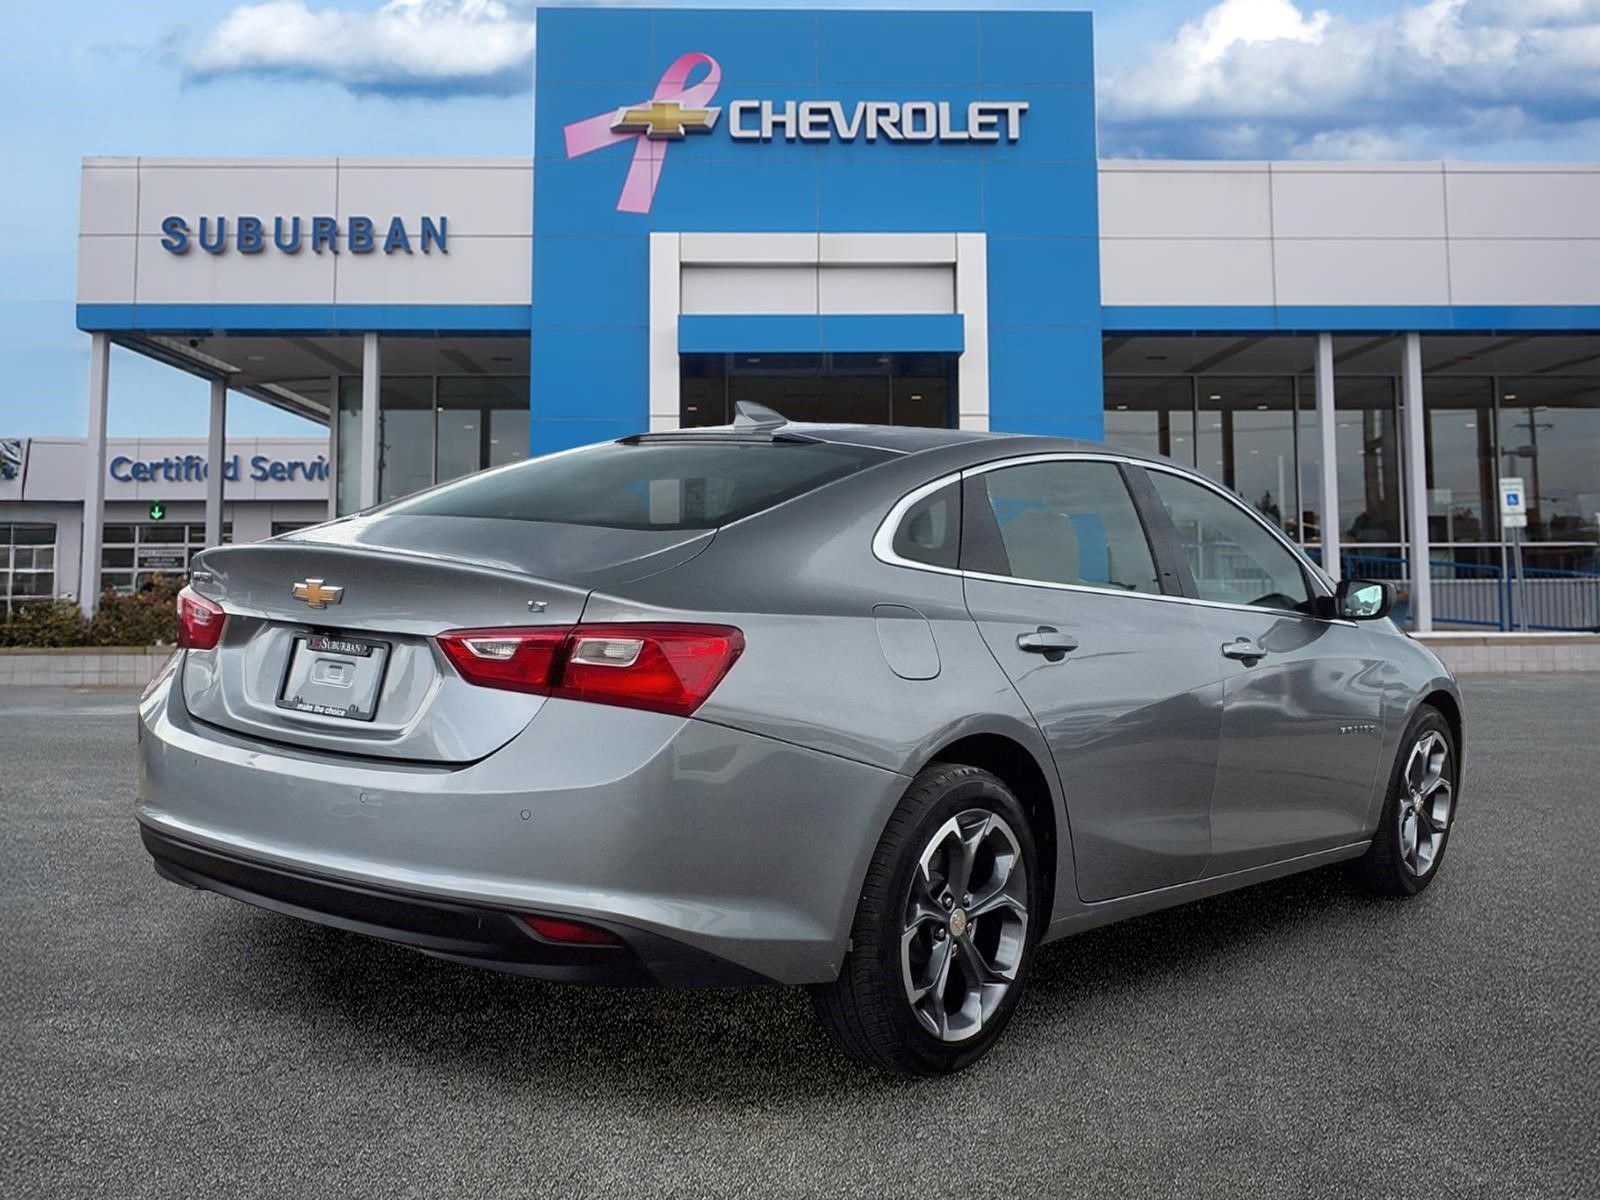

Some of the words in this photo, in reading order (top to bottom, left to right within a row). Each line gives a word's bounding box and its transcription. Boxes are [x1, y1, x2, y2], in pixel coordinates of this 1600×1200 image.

[729, 100, 1029, 140] CHEVROLET
[161, 216, 449, 254] SUBURBAN
[110, 455, 240, 481] Certifid
[321, 637, 361, 652] SUBURBAN
